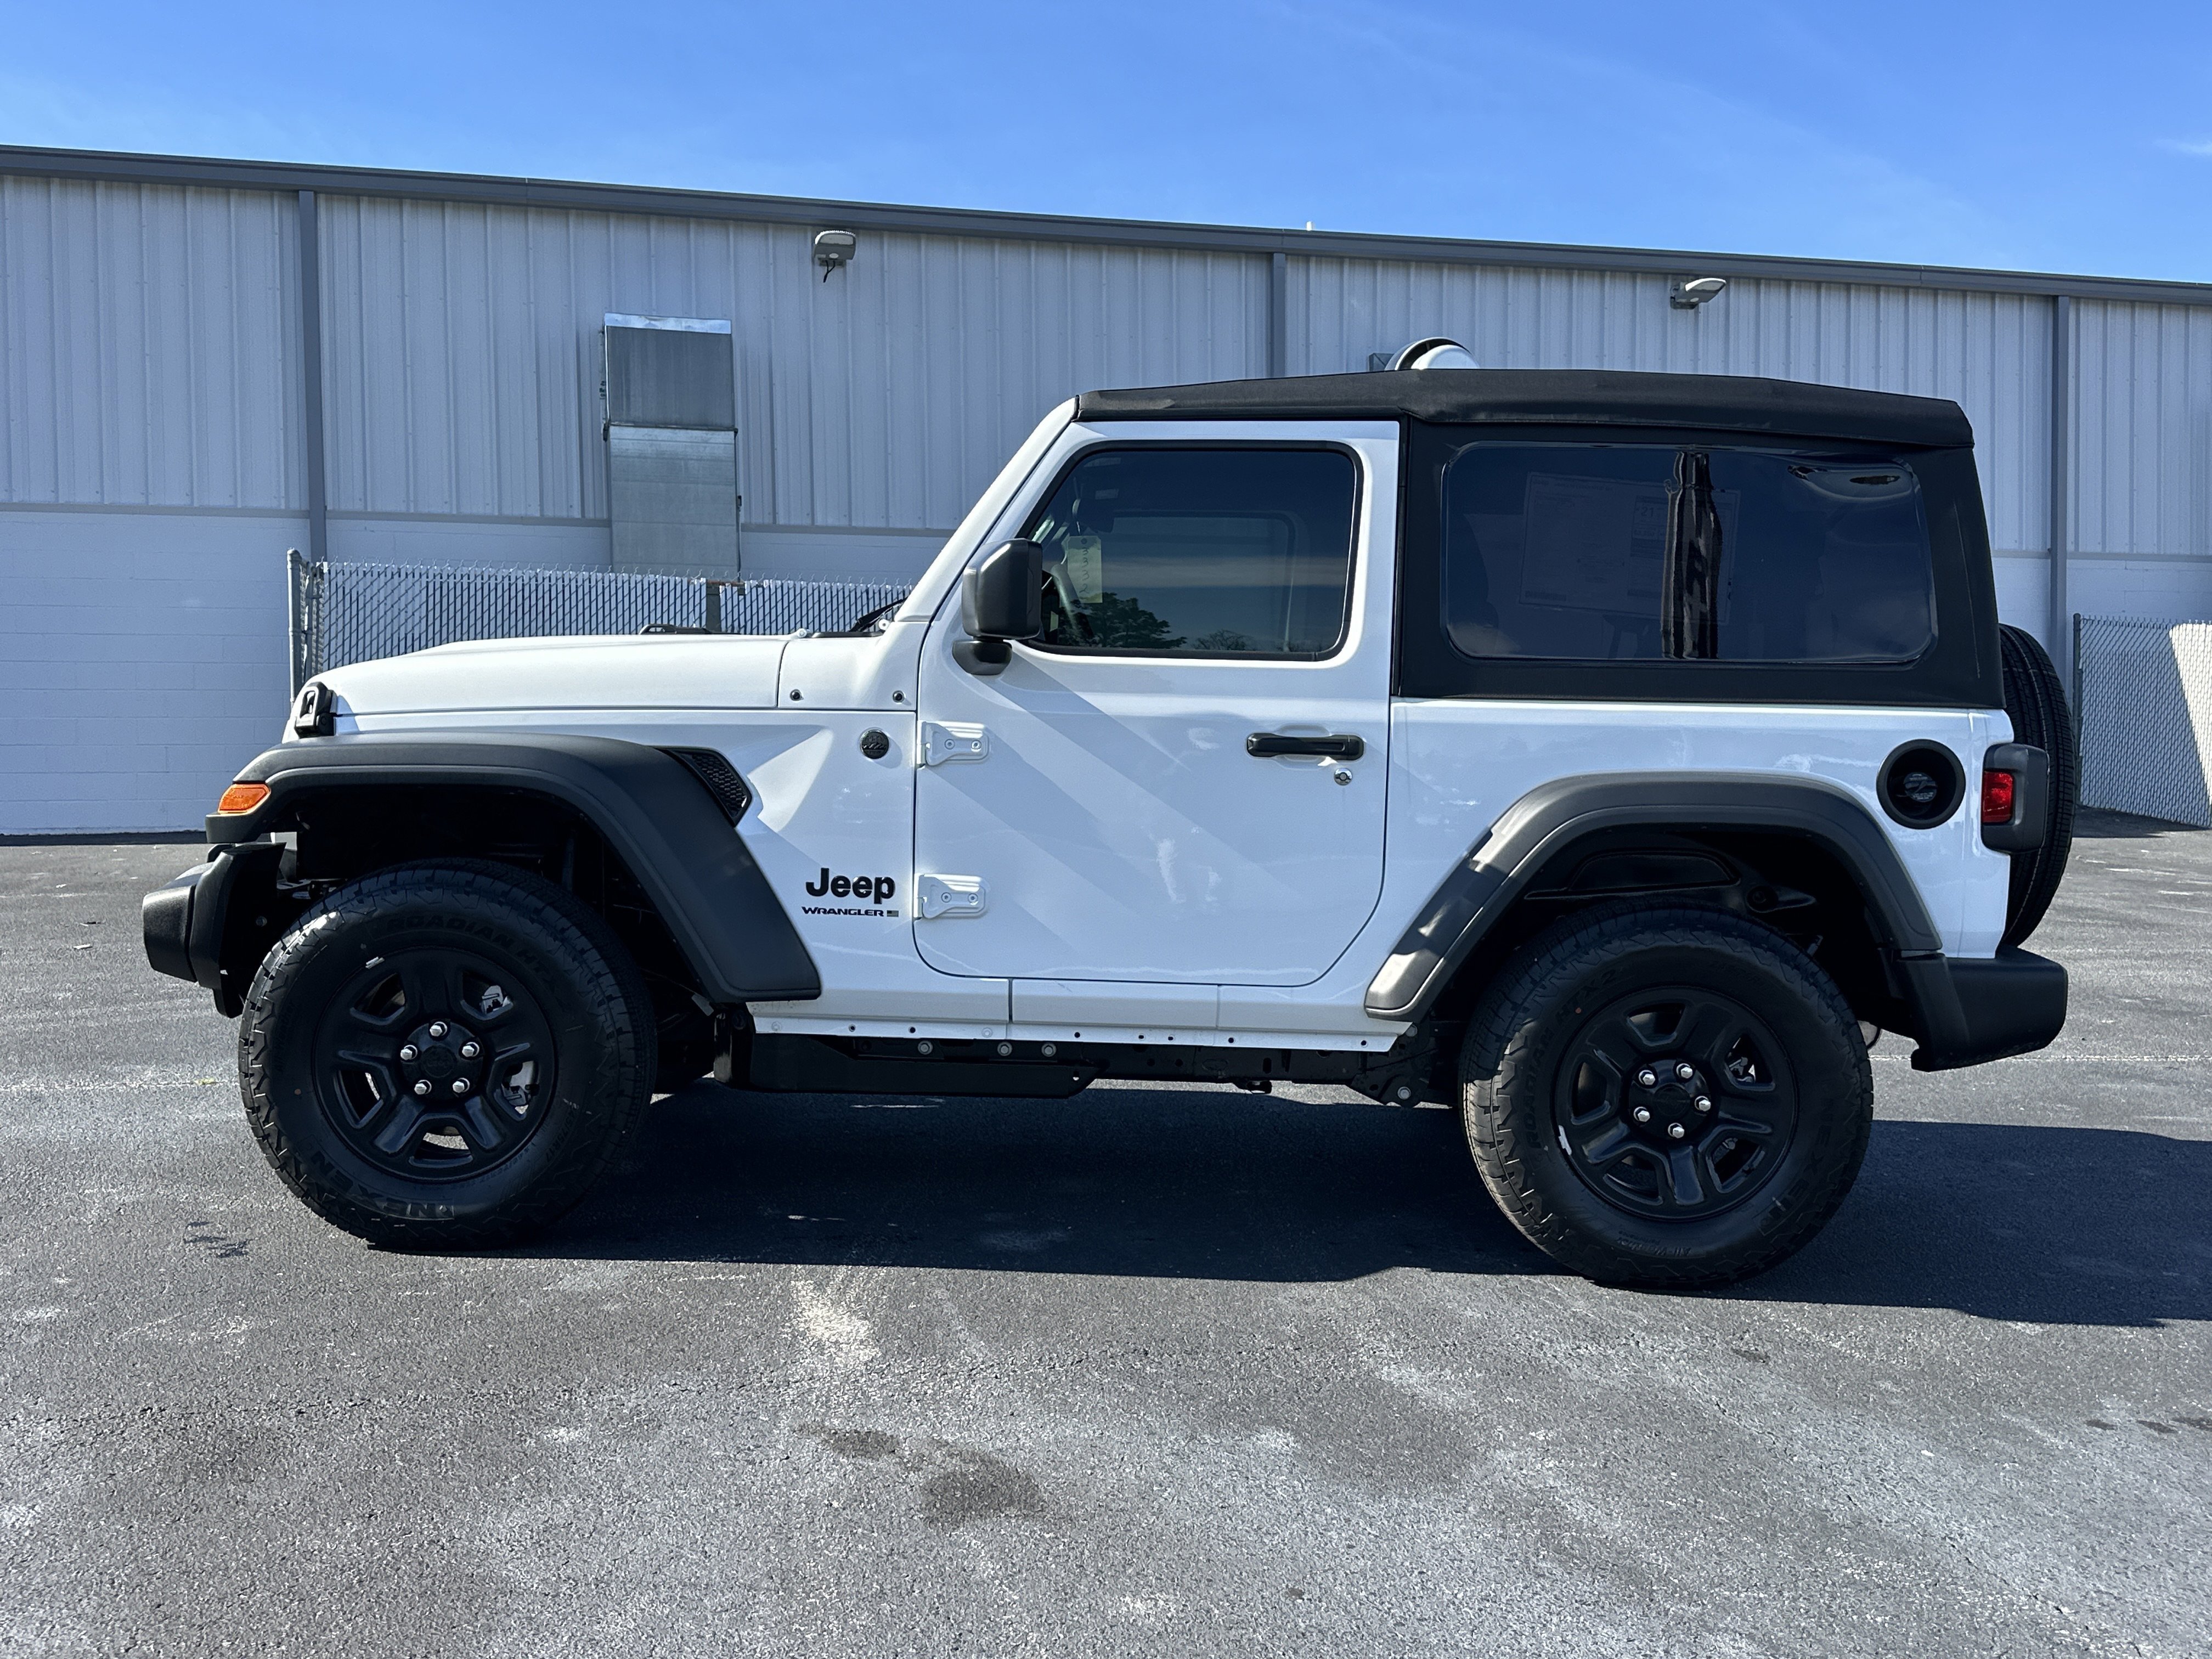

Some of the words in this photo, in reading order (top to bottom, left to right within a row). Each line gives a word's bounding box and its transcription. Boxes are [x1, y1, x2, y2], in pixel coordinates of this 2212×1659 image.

[805, 867, 896, 905] Jeep
[801, 906, 884, 917] WRANGLER
[386, 915, 515, 948] ROADIAN
[1523, 1026, 1555, 1148] ROADIAN
[310, 1149, 436, 1218] NEXEN
